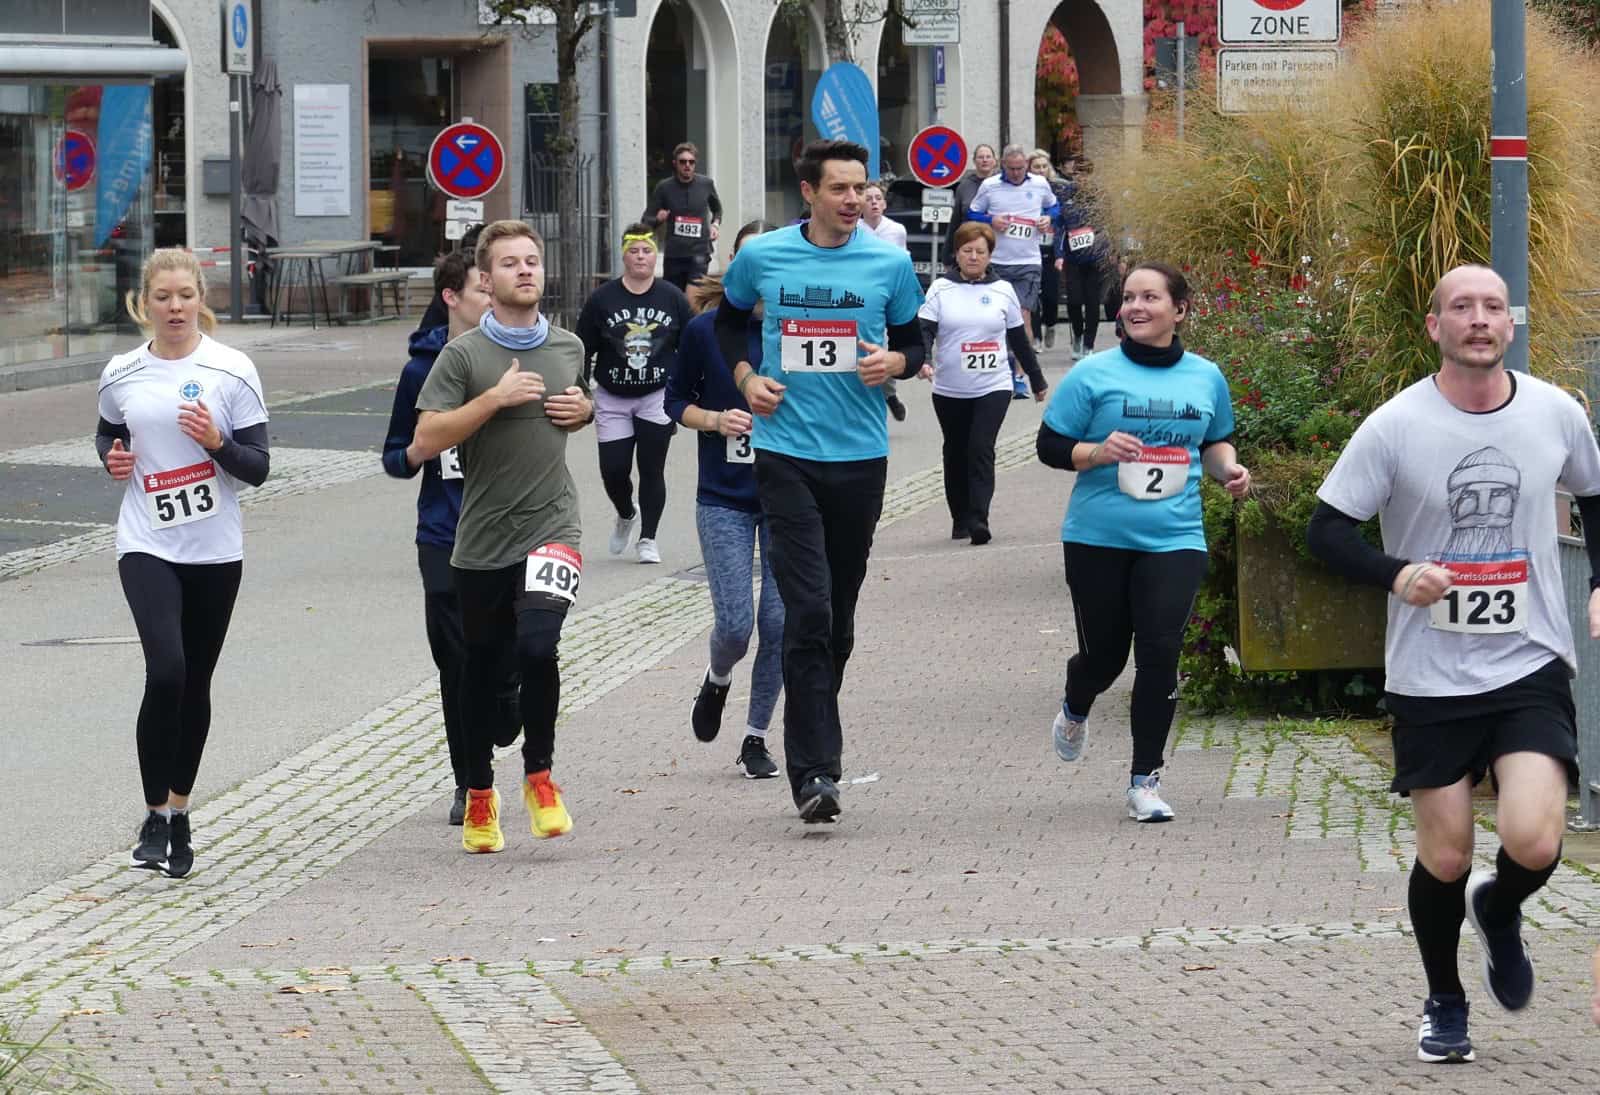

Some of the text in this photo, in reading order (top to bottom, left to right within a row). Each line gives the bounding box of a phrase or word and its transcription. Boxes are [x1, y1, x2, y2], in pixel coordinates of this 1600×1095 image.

[1250, 16, 1310, 35] ZONE
[1225, 60, 1258, 71] Parken
[1262, 60, 1278, 71] mit
[678, 224, 698, 235] 493
[1009, 224, 1032, 238] 210
[1071, 234, 1091, 248] 302
[637, 307, 673, 327] MOMS
[800, 326, 852, 335] Kreissparkasse
[801, 340, 837, 367] 13
[967, 353, 997, 369] 212
[110, 357, 142, 378] uhlsport
[736, 433, 752, 458] 3
[160, 469, 211, 487] Kreissparkasse
[1146, 467, 1164, 494] 2
[155, 484, 214, 522] 513
[549, 549, 582, 569] Kreisspar
[535, 561, 580, 597] 492
[1442, 589, 1516, 625] 123
